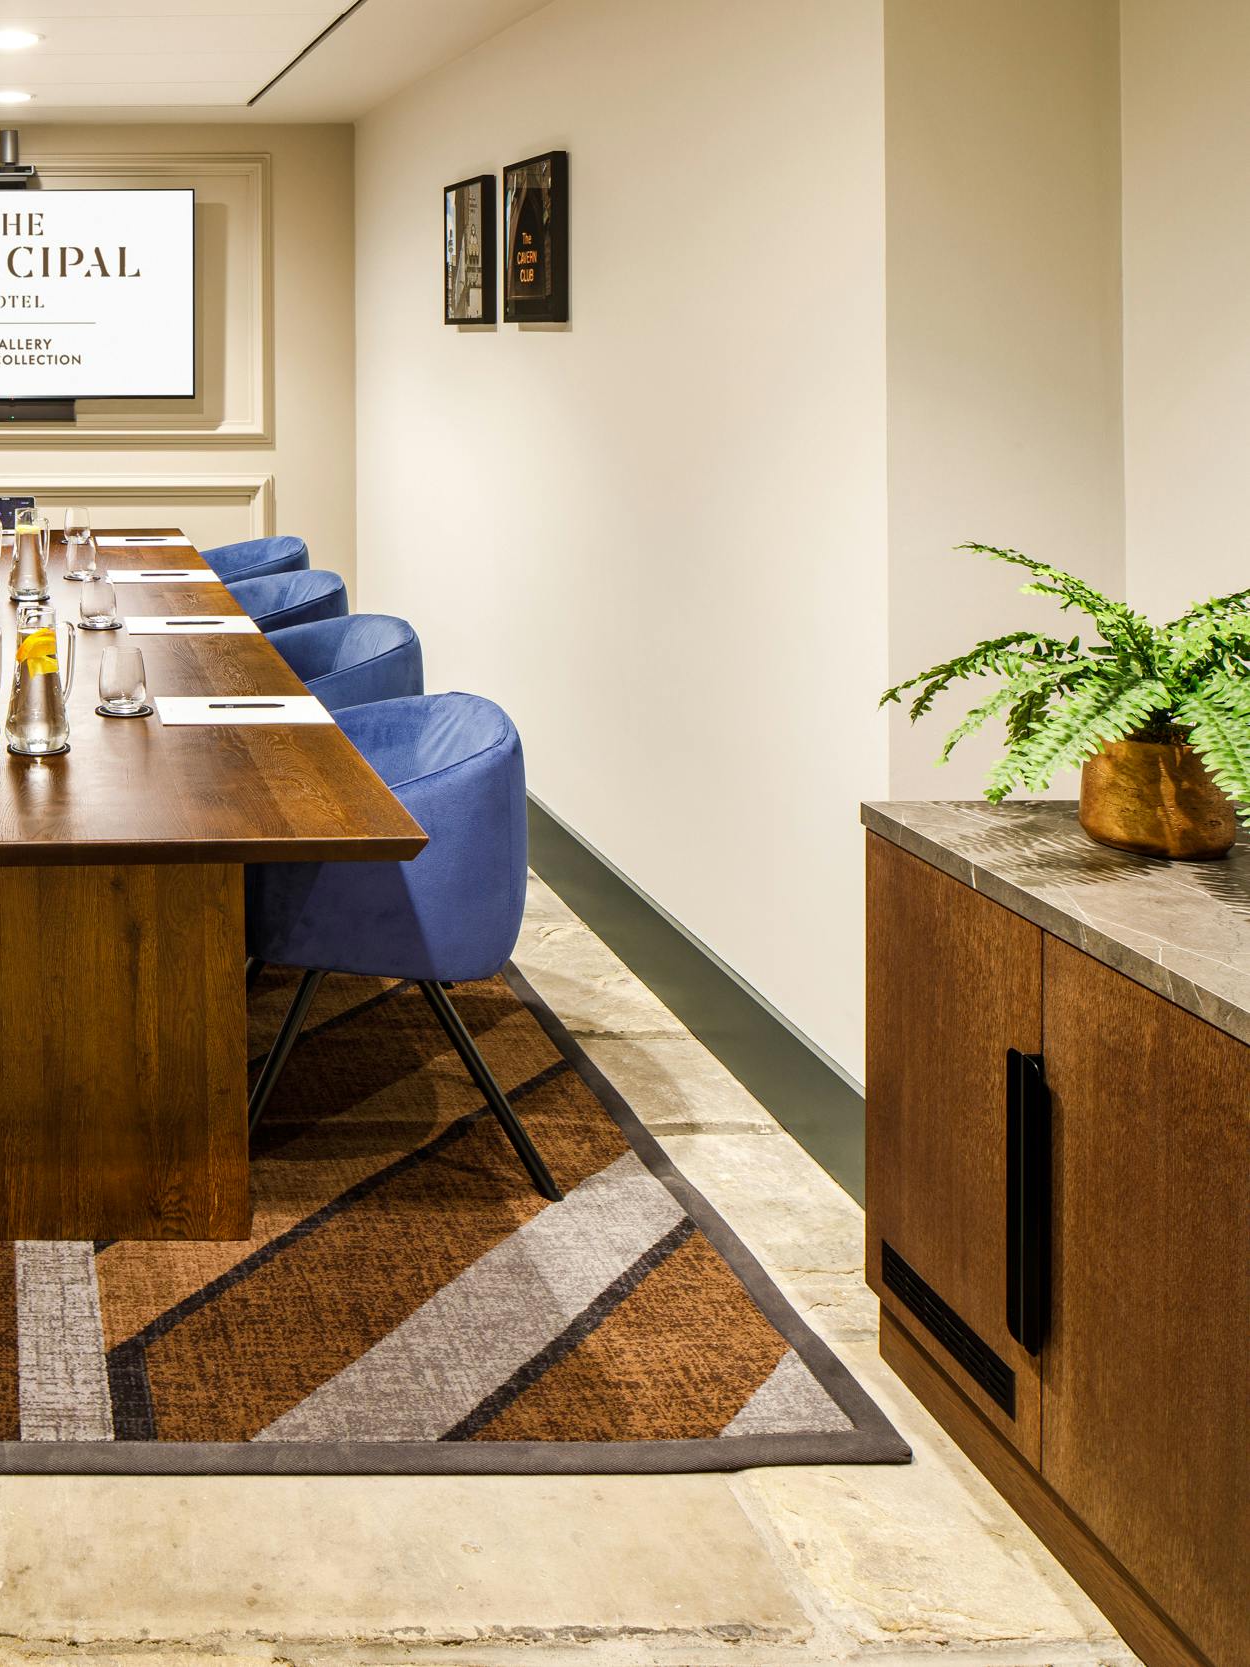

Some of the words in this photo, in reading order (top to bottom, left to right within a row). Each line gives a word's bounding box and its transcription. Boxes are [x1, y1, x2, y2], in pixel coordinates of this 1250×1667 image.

[522, 232, 532, 245] The
[517, 250, 538, 265] CAVERN
[520, 268, 534, 282] CLUB
